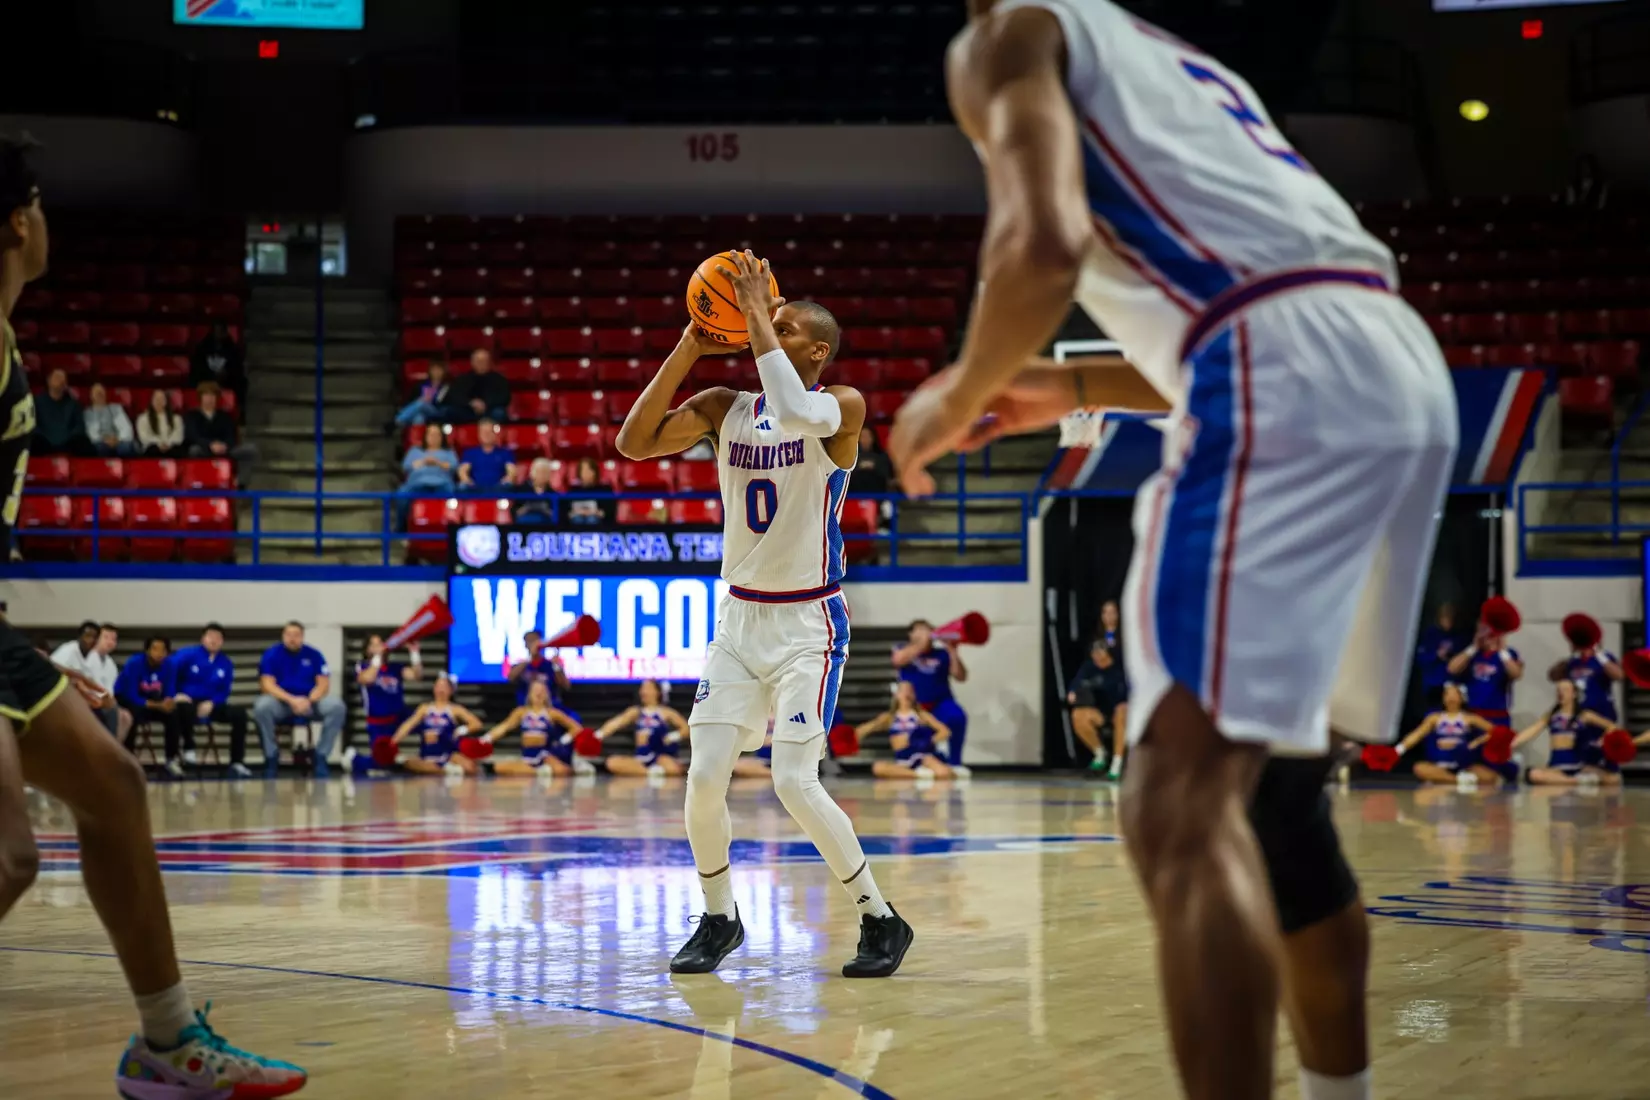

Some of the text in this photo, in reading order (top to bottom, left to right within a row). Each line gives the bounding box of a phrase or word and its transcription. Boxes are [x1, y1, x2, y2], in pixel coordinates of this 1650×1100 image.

[686, 132, 739, 162] 105
[728, 438, 805, 470] OUISANA TECH
[745, 478, 778, 534] 0
[507, 532, 673, 562] LOUISIANA
[471, 578, 730, 664] WELCO
